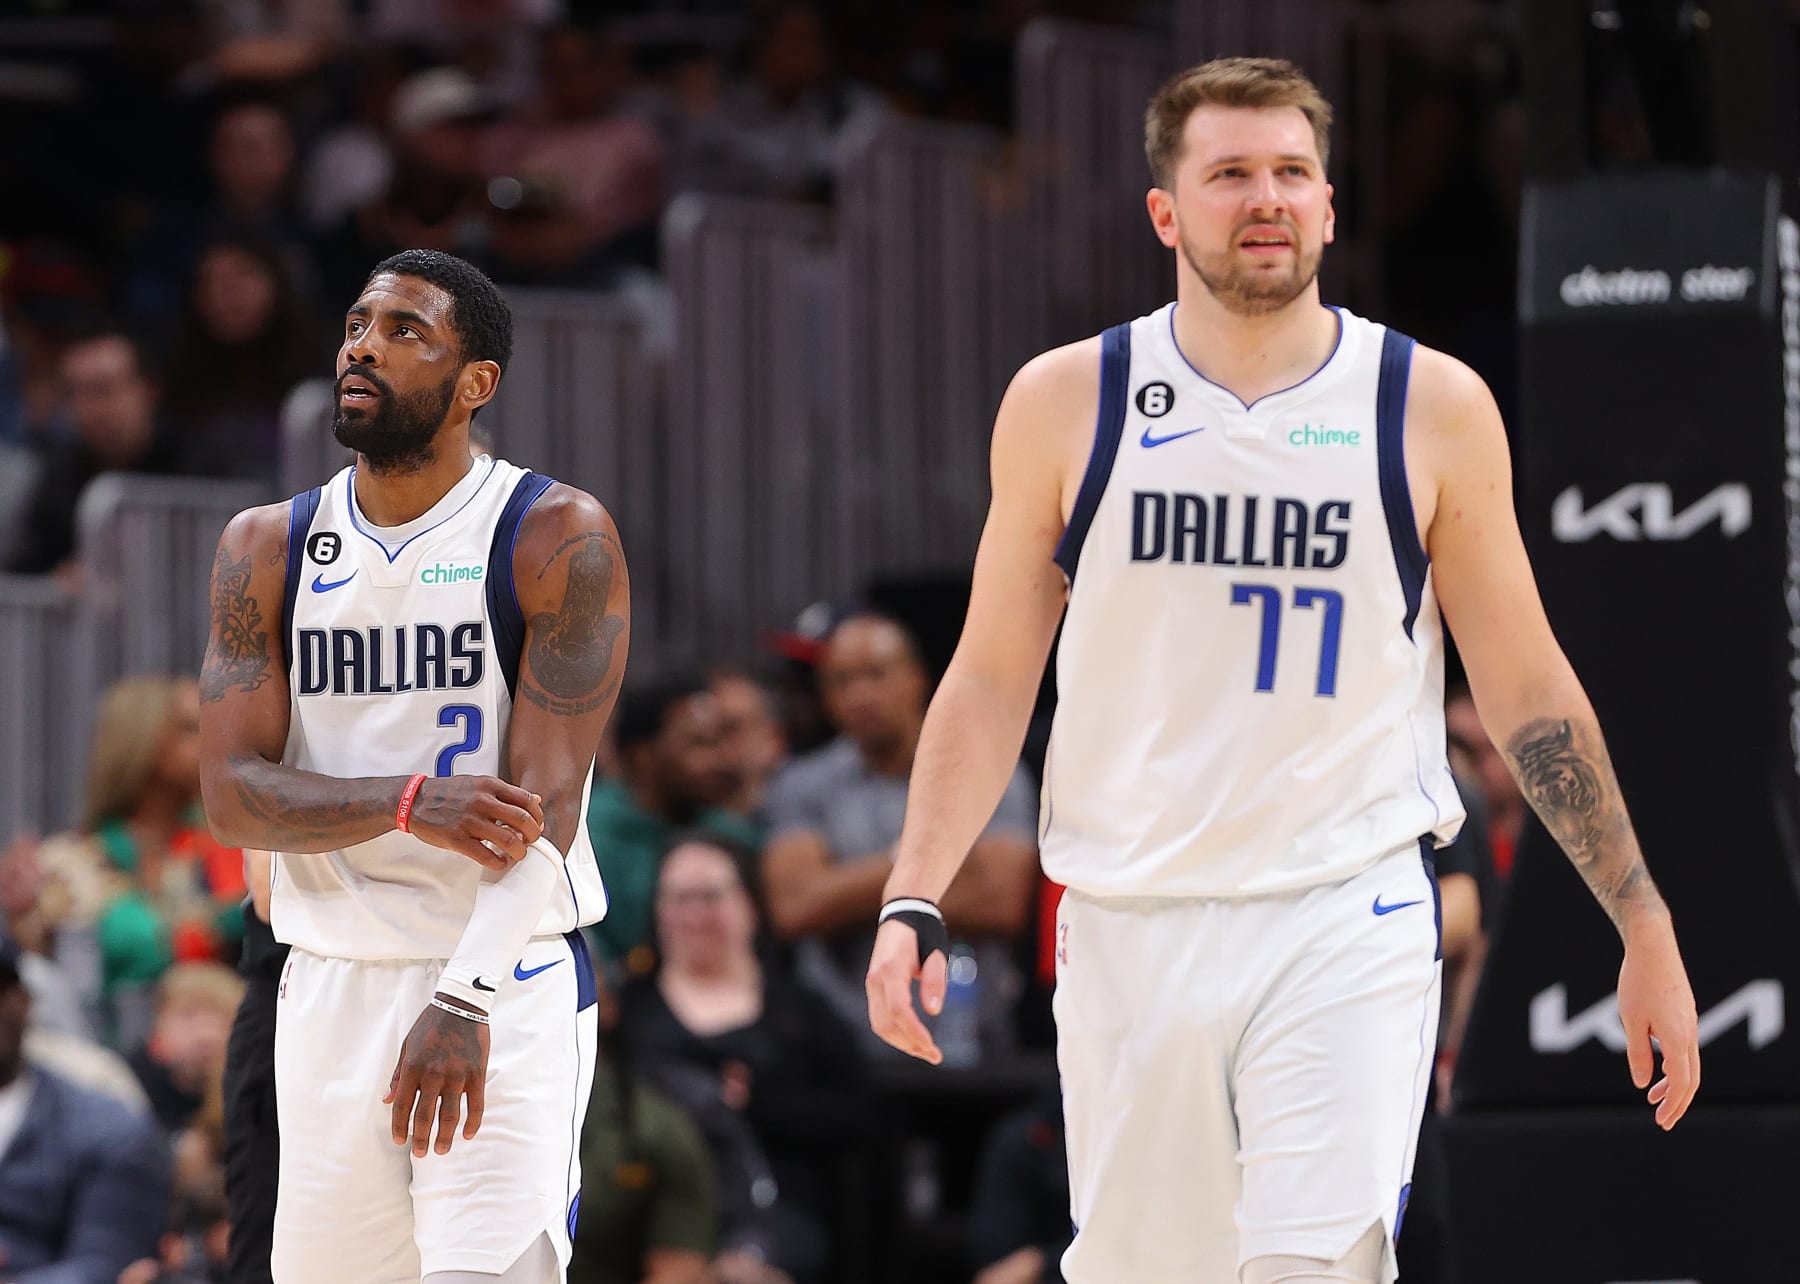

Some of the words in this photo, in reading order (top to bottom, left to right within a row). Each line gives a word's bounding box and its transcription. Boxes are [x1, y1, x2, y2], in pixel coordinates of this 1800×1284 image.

[1142, 384, 1169, 416] 6
[1289, 424, 1361, 447] chime
[312, 534, 338, 563] 6
[1129, 489, 1353, 570] DALLAS
[421, 563, 483, 584] chime
[297, 620, 486, 697] DALLAS
[1229, 582, 1345, 698] 77
[436, 703, 484, 777] 2
